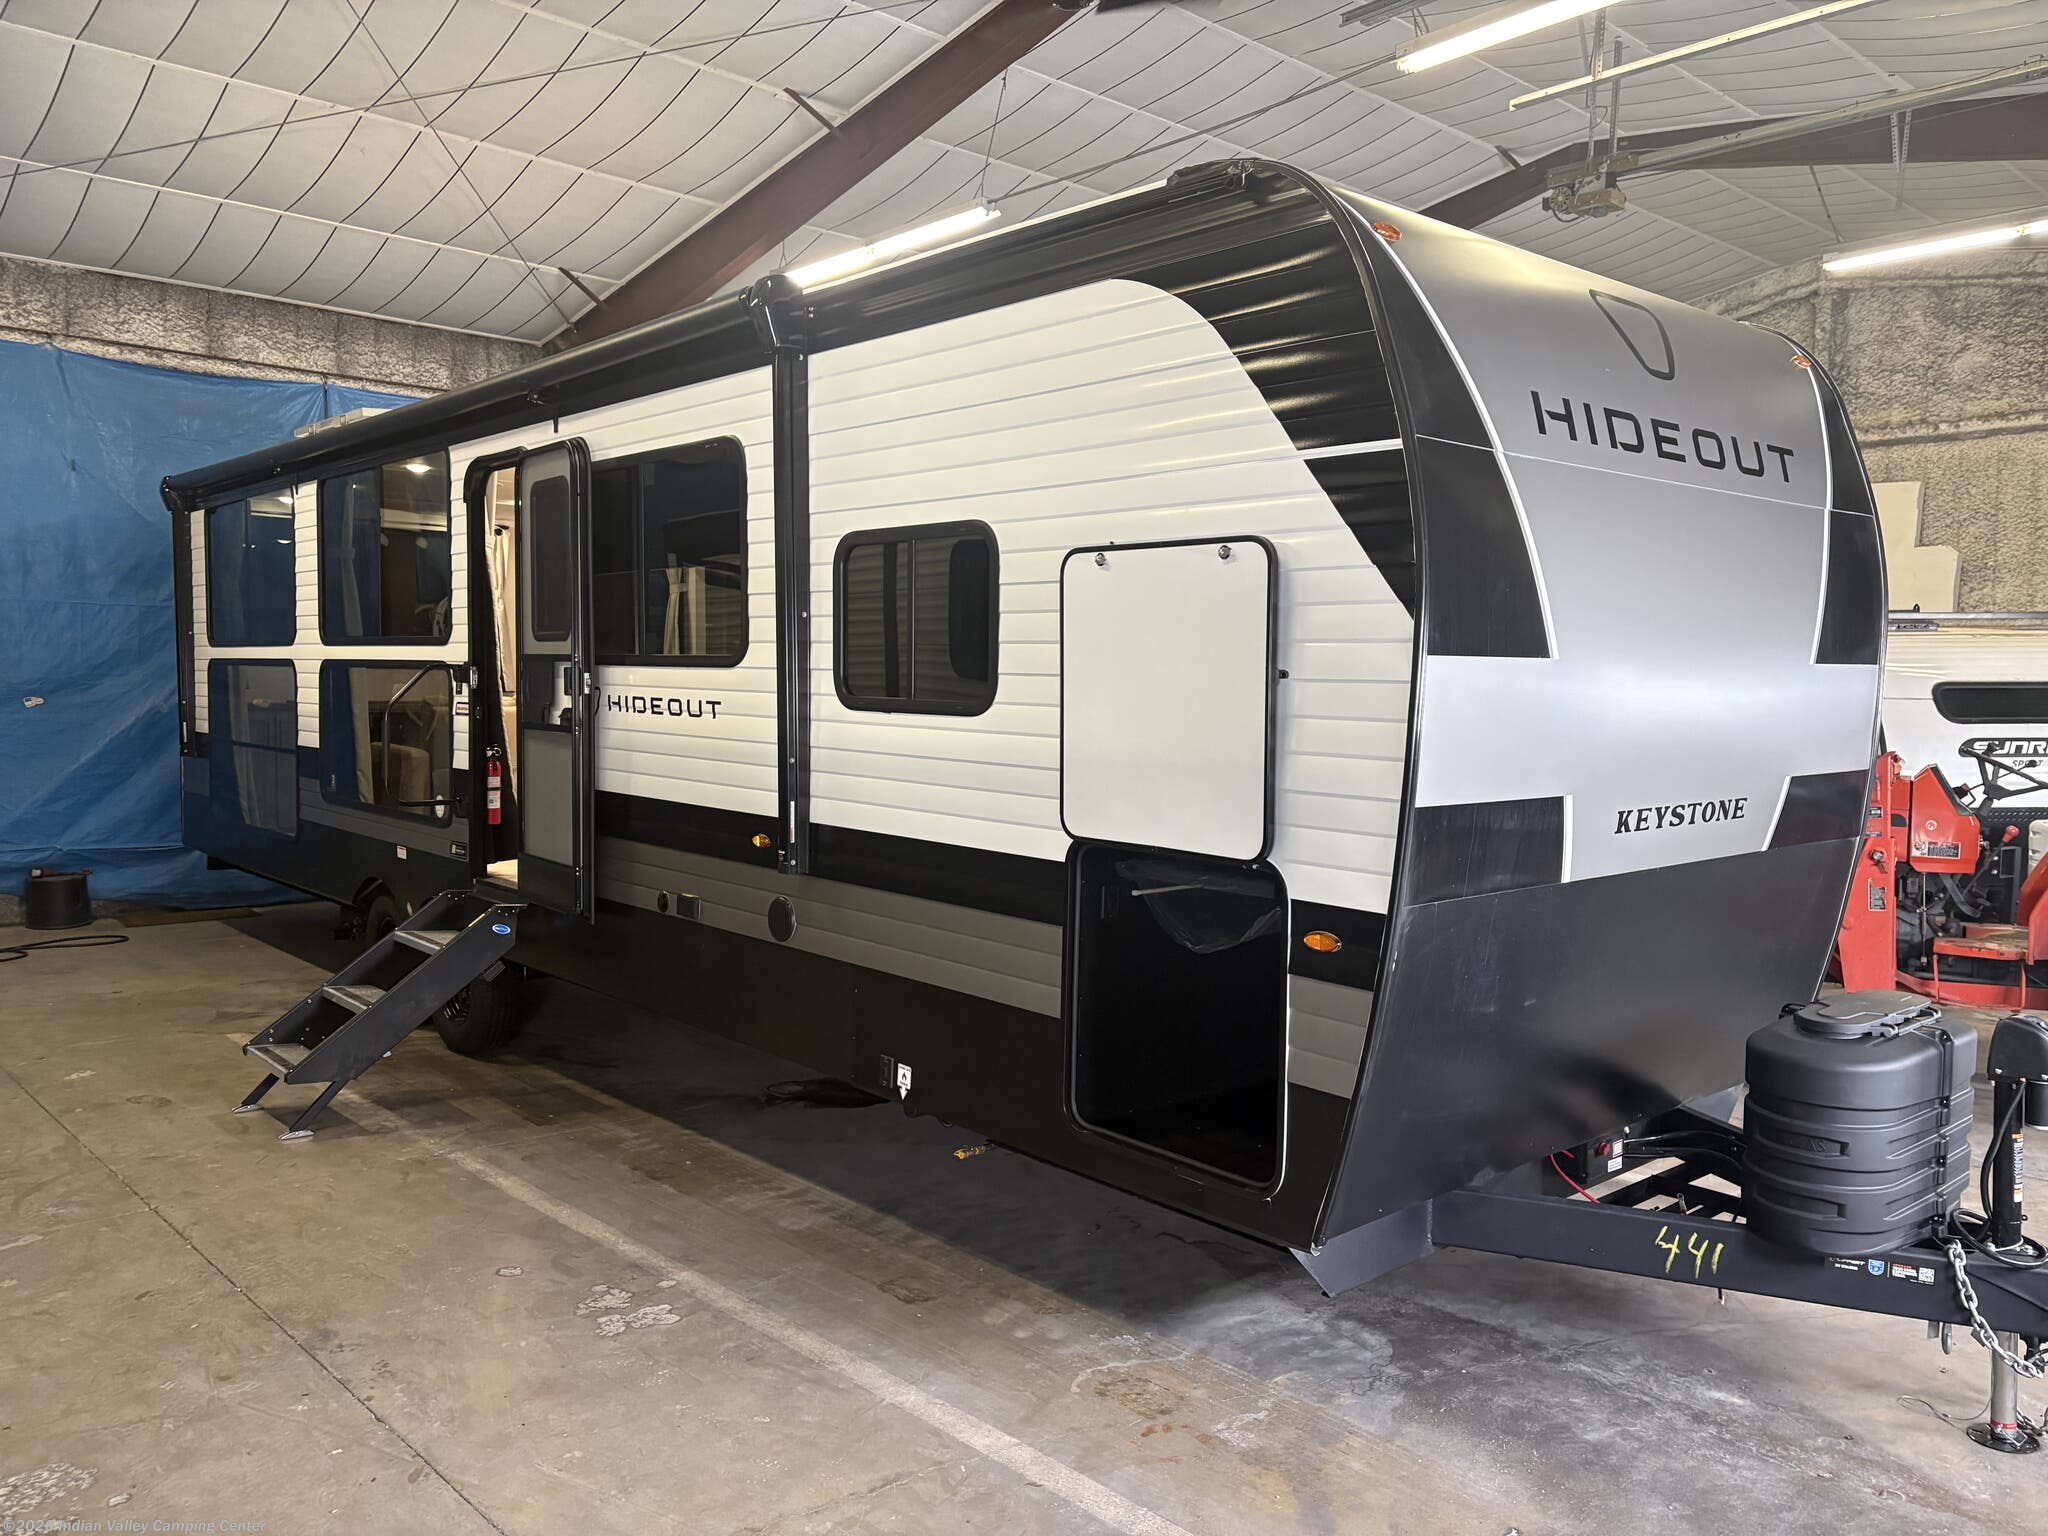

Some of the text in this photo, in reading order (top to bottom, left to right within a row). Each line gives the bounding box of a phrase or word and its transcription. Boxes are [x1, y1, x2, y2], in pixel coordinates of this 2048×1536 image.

[1530, 390, 1794, 483] HIDEOUT
[608, 694, 721, 719] HIDEOUT
[1614, 797, 1748, 834] KEYSTONE
[1655, 1226, 1724, 1279] 441
